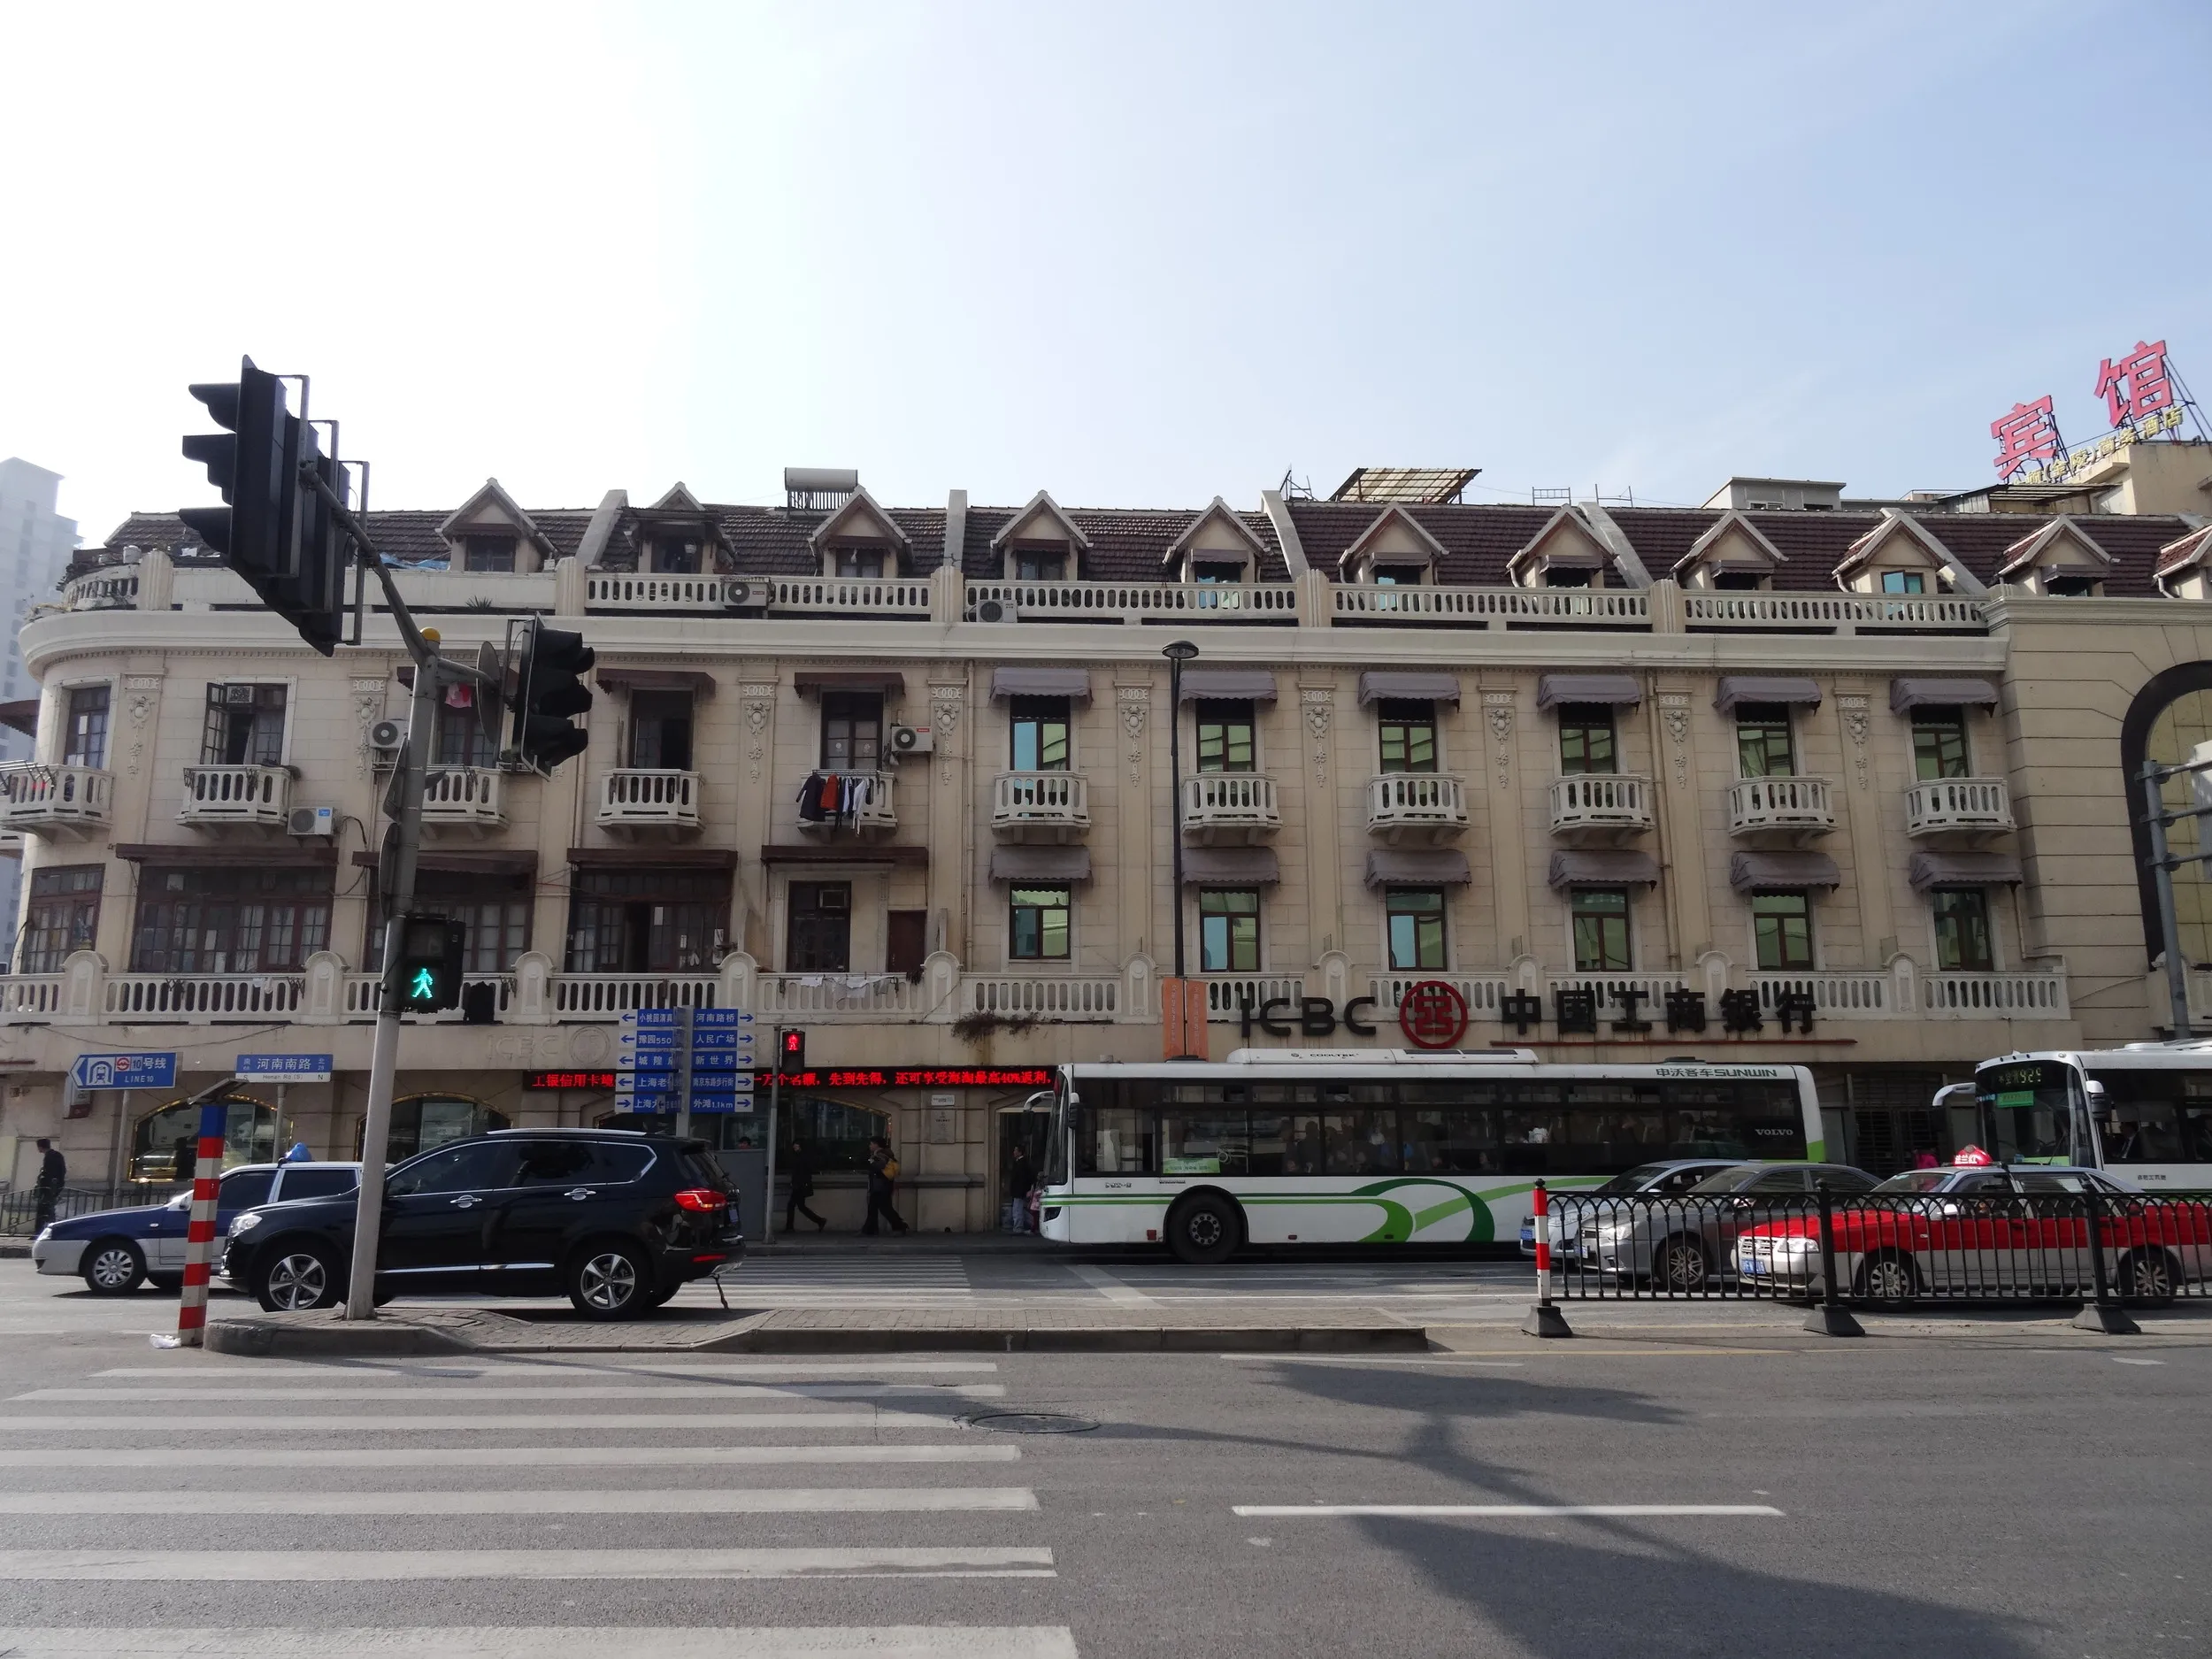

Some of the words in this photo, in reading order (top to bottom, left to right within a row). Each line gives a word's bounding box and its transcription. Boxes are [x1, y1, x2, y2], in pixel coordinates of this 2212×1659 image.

[1990, 339, 2173, 480] 宾馆
[1241, 996, 1377, 1037] ICBC
[1502, 988, 1816, 1034] 中国工商银行
[695, 1013, 735, 1023] 河南路桥
[695, 1034, 735, 1044] 人民广场
[257, 1057, 311, 1070] 河南南路
[695, 1056, 734, 1065] 新世界
[1655, 1068, 1714, 1078] 申沃客车
[1715, 1069, 1778, 1078] SUNWIN
